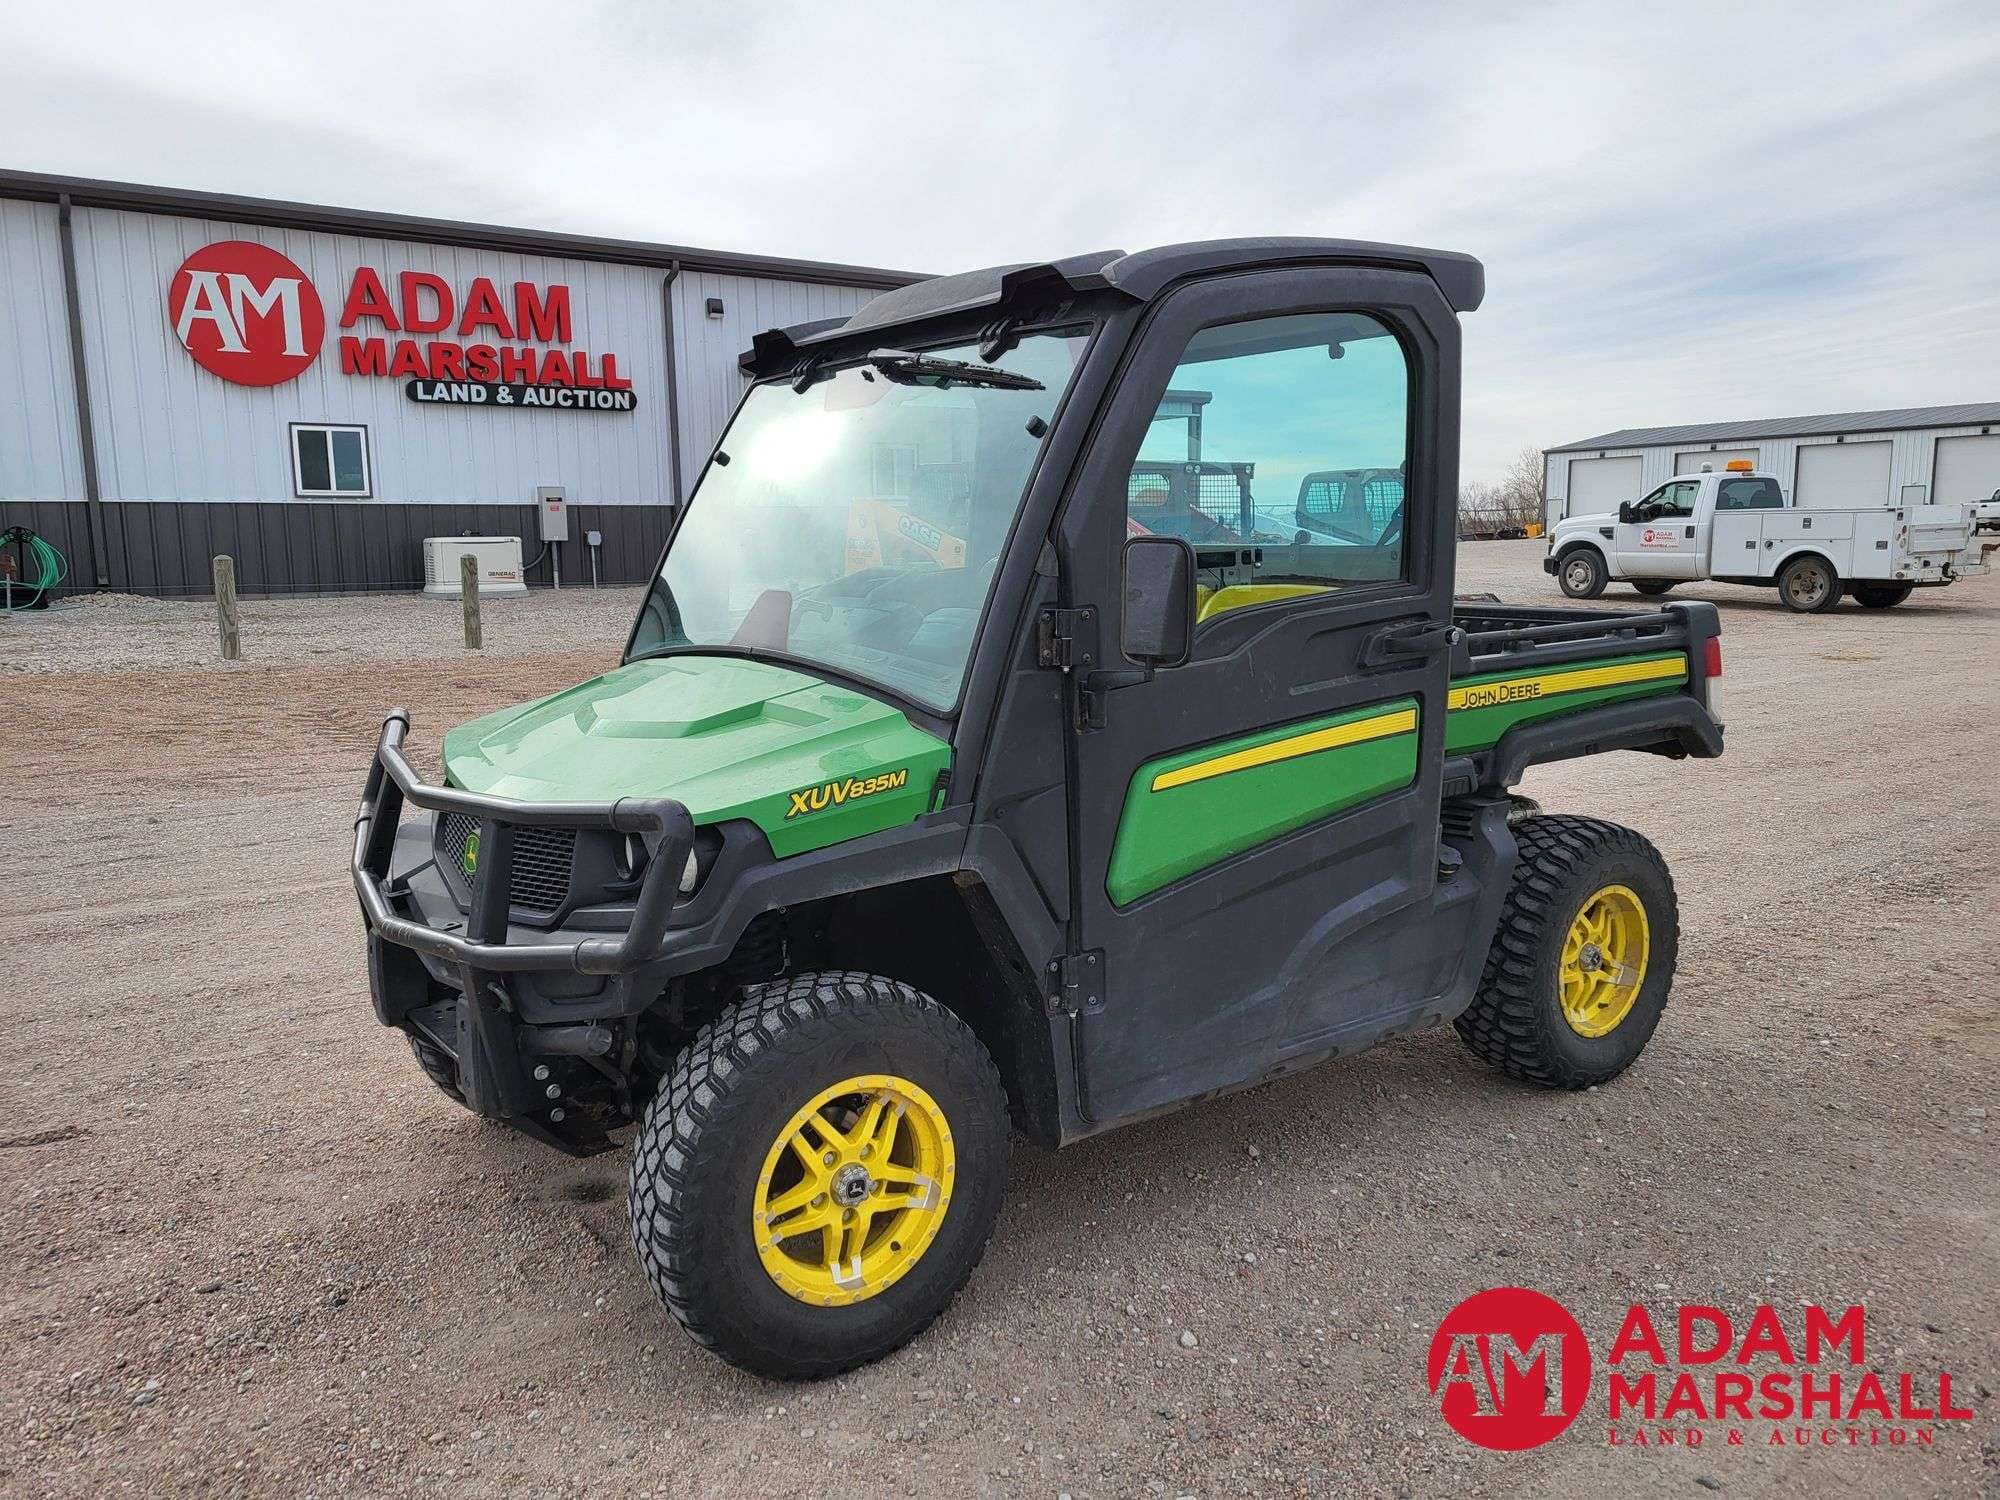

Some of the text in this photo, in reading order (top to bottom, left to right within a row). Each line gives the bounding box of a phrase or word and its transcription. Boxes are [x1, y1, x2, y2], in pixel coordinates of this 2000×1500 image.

[174, 269, 311, 357] AM
[339, 266, 572, 343] ADAM
[339, 335, 633, 390] MARSHALL
[416, 380, 632, 410] LAND & AUCTION
[1460, 683, 1541, 708] JOHN DEERE
[785, 768, 908, 818] XUV835M
